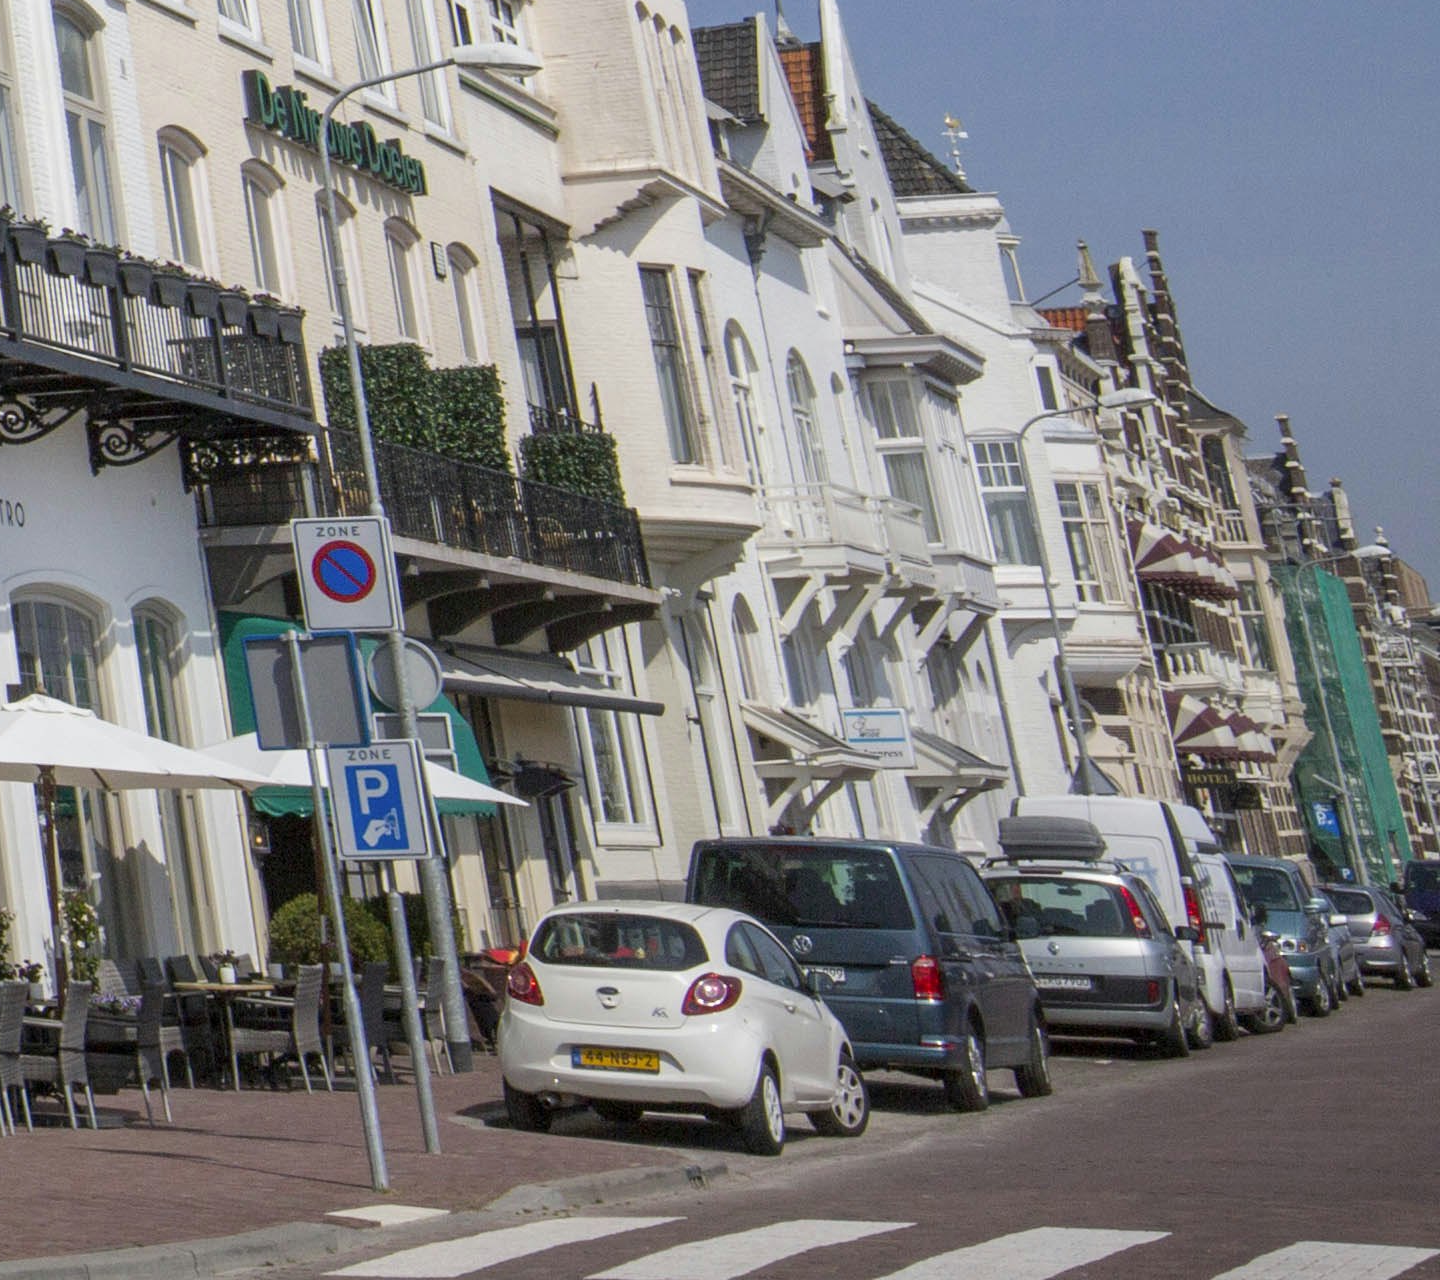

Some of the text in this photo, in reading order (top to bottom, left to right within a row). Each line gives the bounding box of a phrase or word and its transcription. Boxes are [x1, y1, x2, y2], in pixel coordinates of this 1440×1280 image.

[244, 69, 289, 132] De
[352, 121, 428, 196] Doelen
[315, 525, 360, 537] ZONE
[347, 748, 392, 760] ZONE
[355, 769, 389, 815] P
